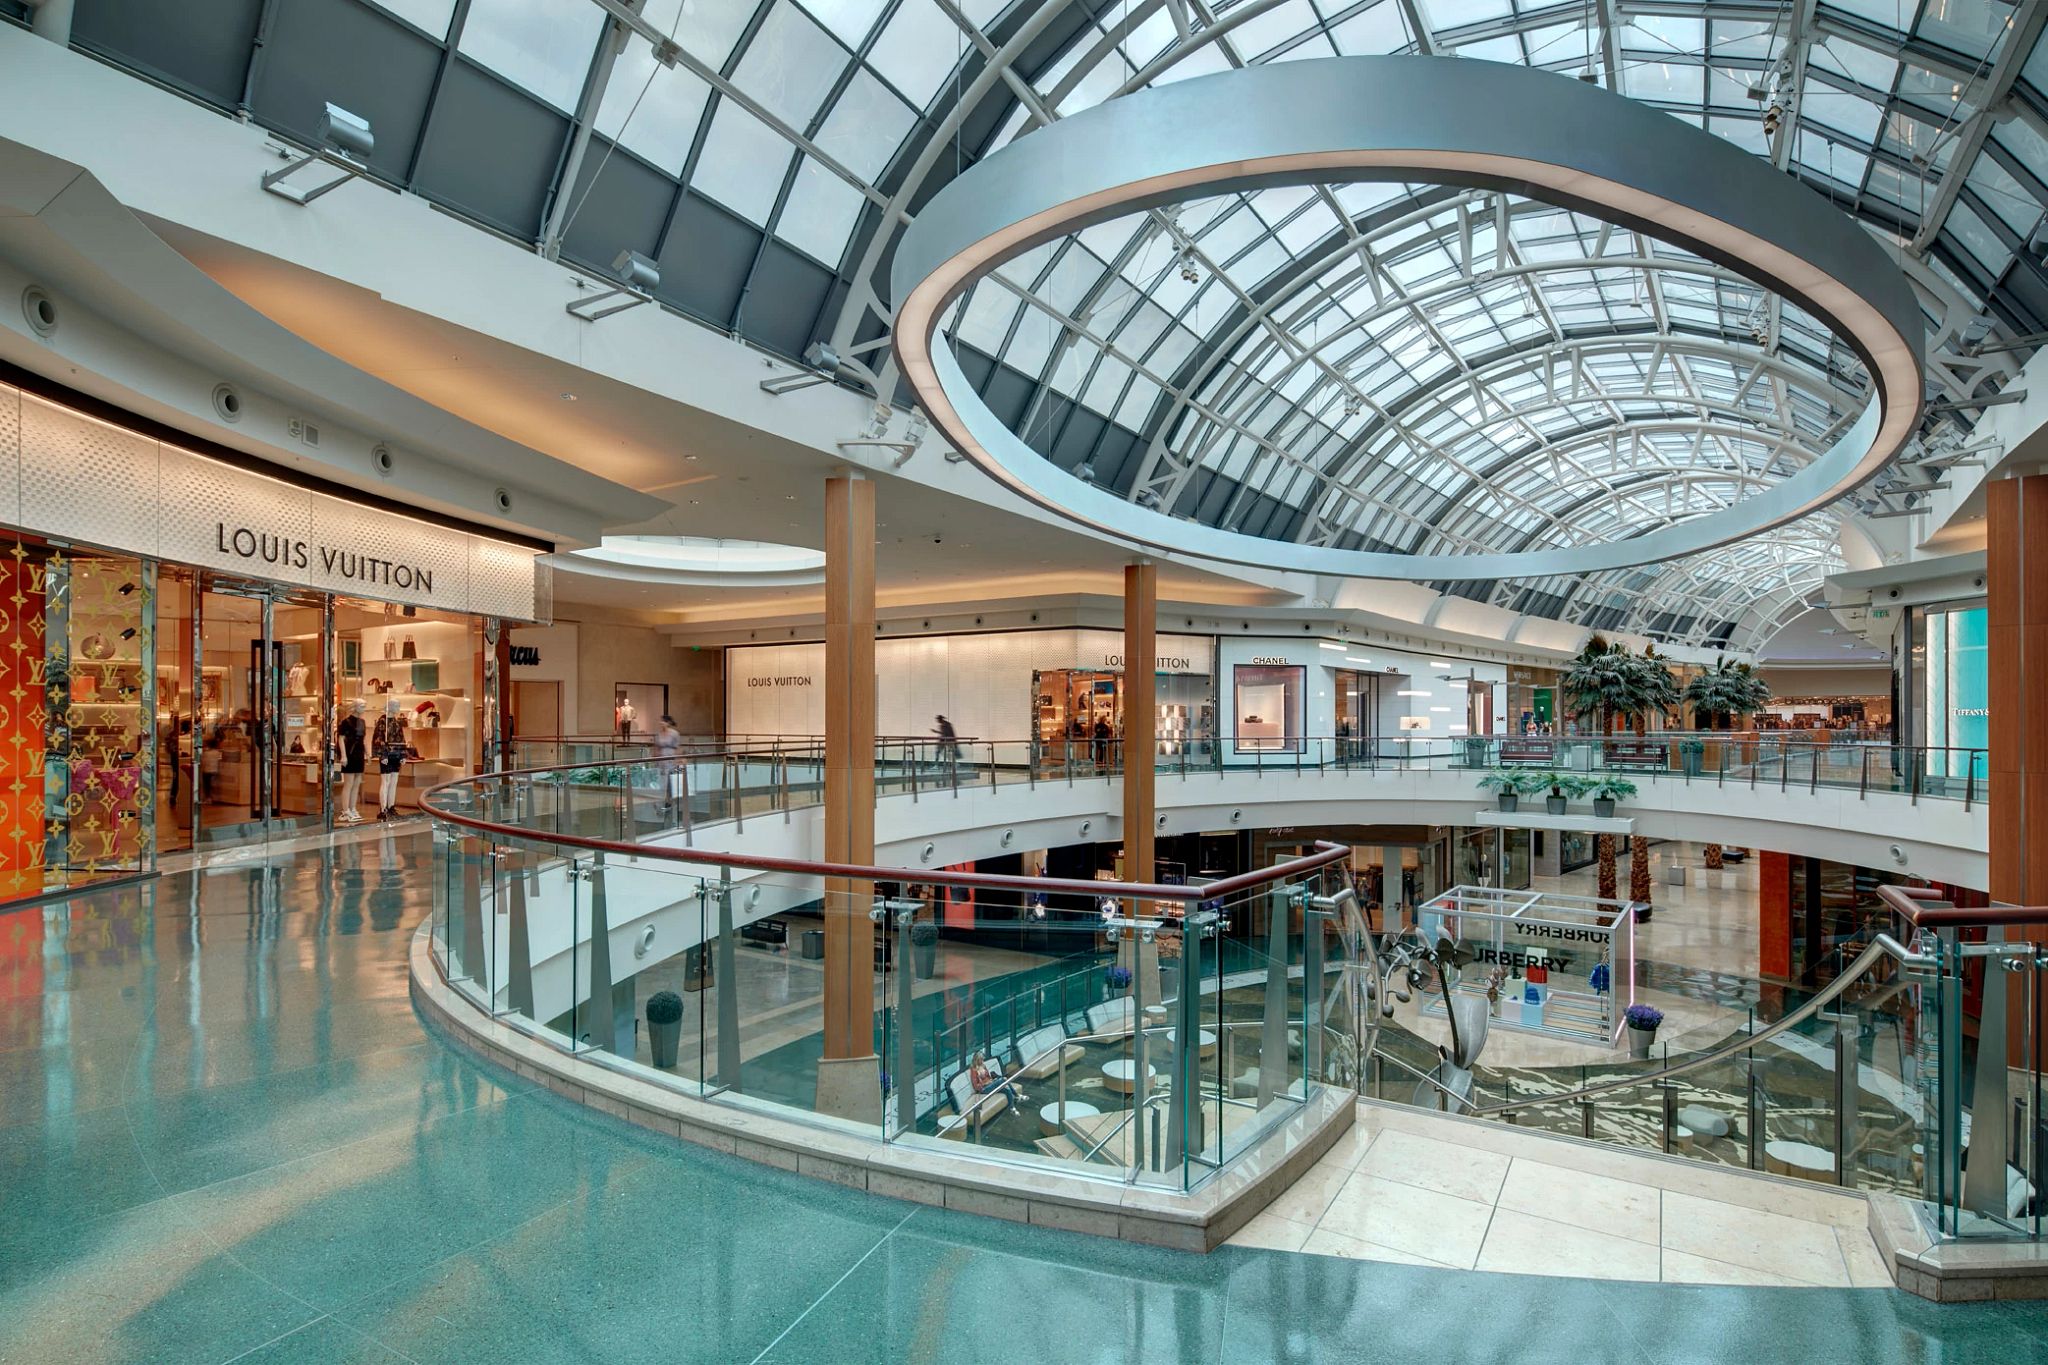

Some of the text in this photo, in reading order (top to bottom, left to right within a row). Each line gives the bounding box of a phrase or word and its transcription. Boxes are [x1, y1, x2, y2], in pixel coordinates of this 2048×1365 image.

[217, 523, 432, 594] LOUIS VUITTON
[1104, 655, 1190, 669] LOU ITTON
[1252, 657, 1290, 665] CHANEL
[747, 676, 811, 687] LOUIS VUITTON
[1473, 948, 1569, 973] URBERRY
